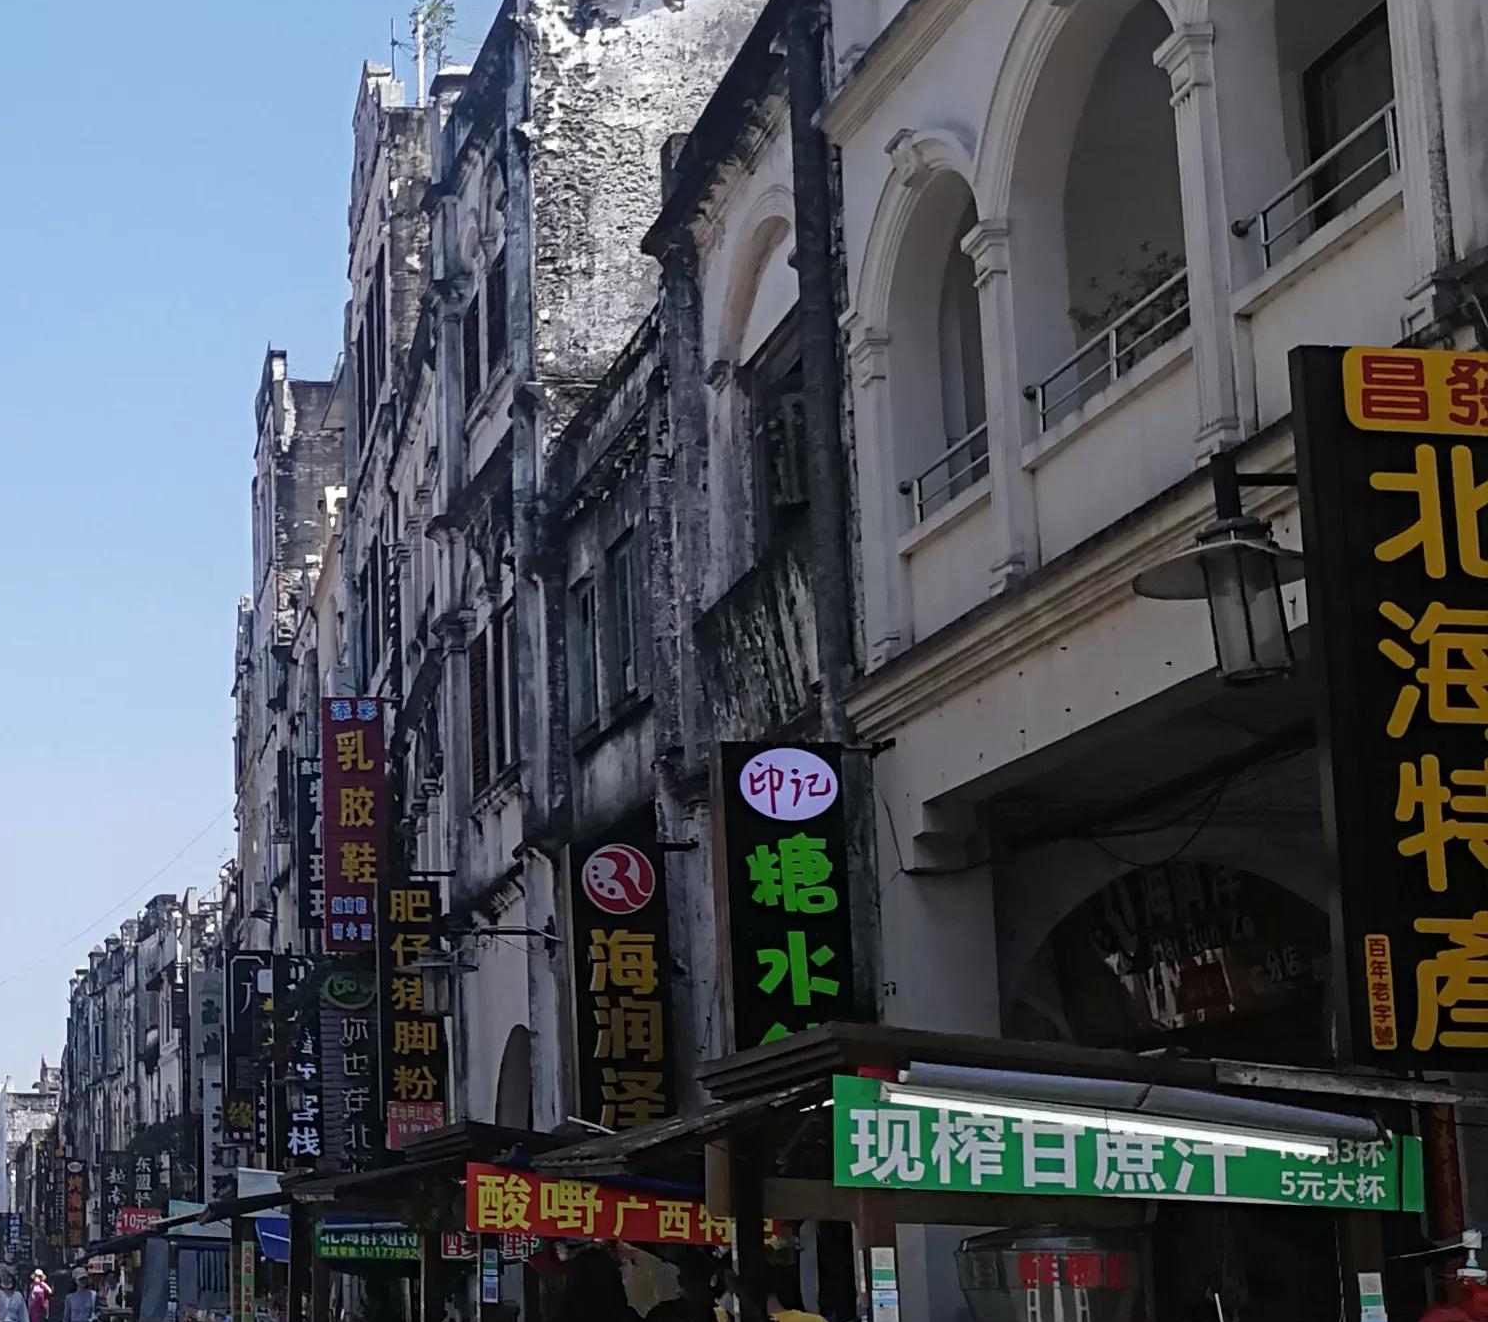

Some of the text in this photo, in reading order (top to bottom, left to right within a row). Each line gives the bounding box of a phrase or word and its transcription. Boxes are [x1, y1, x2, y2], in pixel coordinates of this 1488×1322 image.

[335, 730, 377, 884] 乳胶鞋
[748, 761, 832, 815] 印记
[389, 889, 438, 1101] 肥仔猪脚粉
[746, 832, 840, 1051] 糖水
[1367, 937, 1394, 1046] 百年老字號
[589, 929, 666, 1131] 海润泽
[477, 1174, 604, 1235] 酸嘢
[849, 1107, 1247, 1197] 现榨甘蔗汁
[1281, 1170, 1387, 1204] 5元大杯
